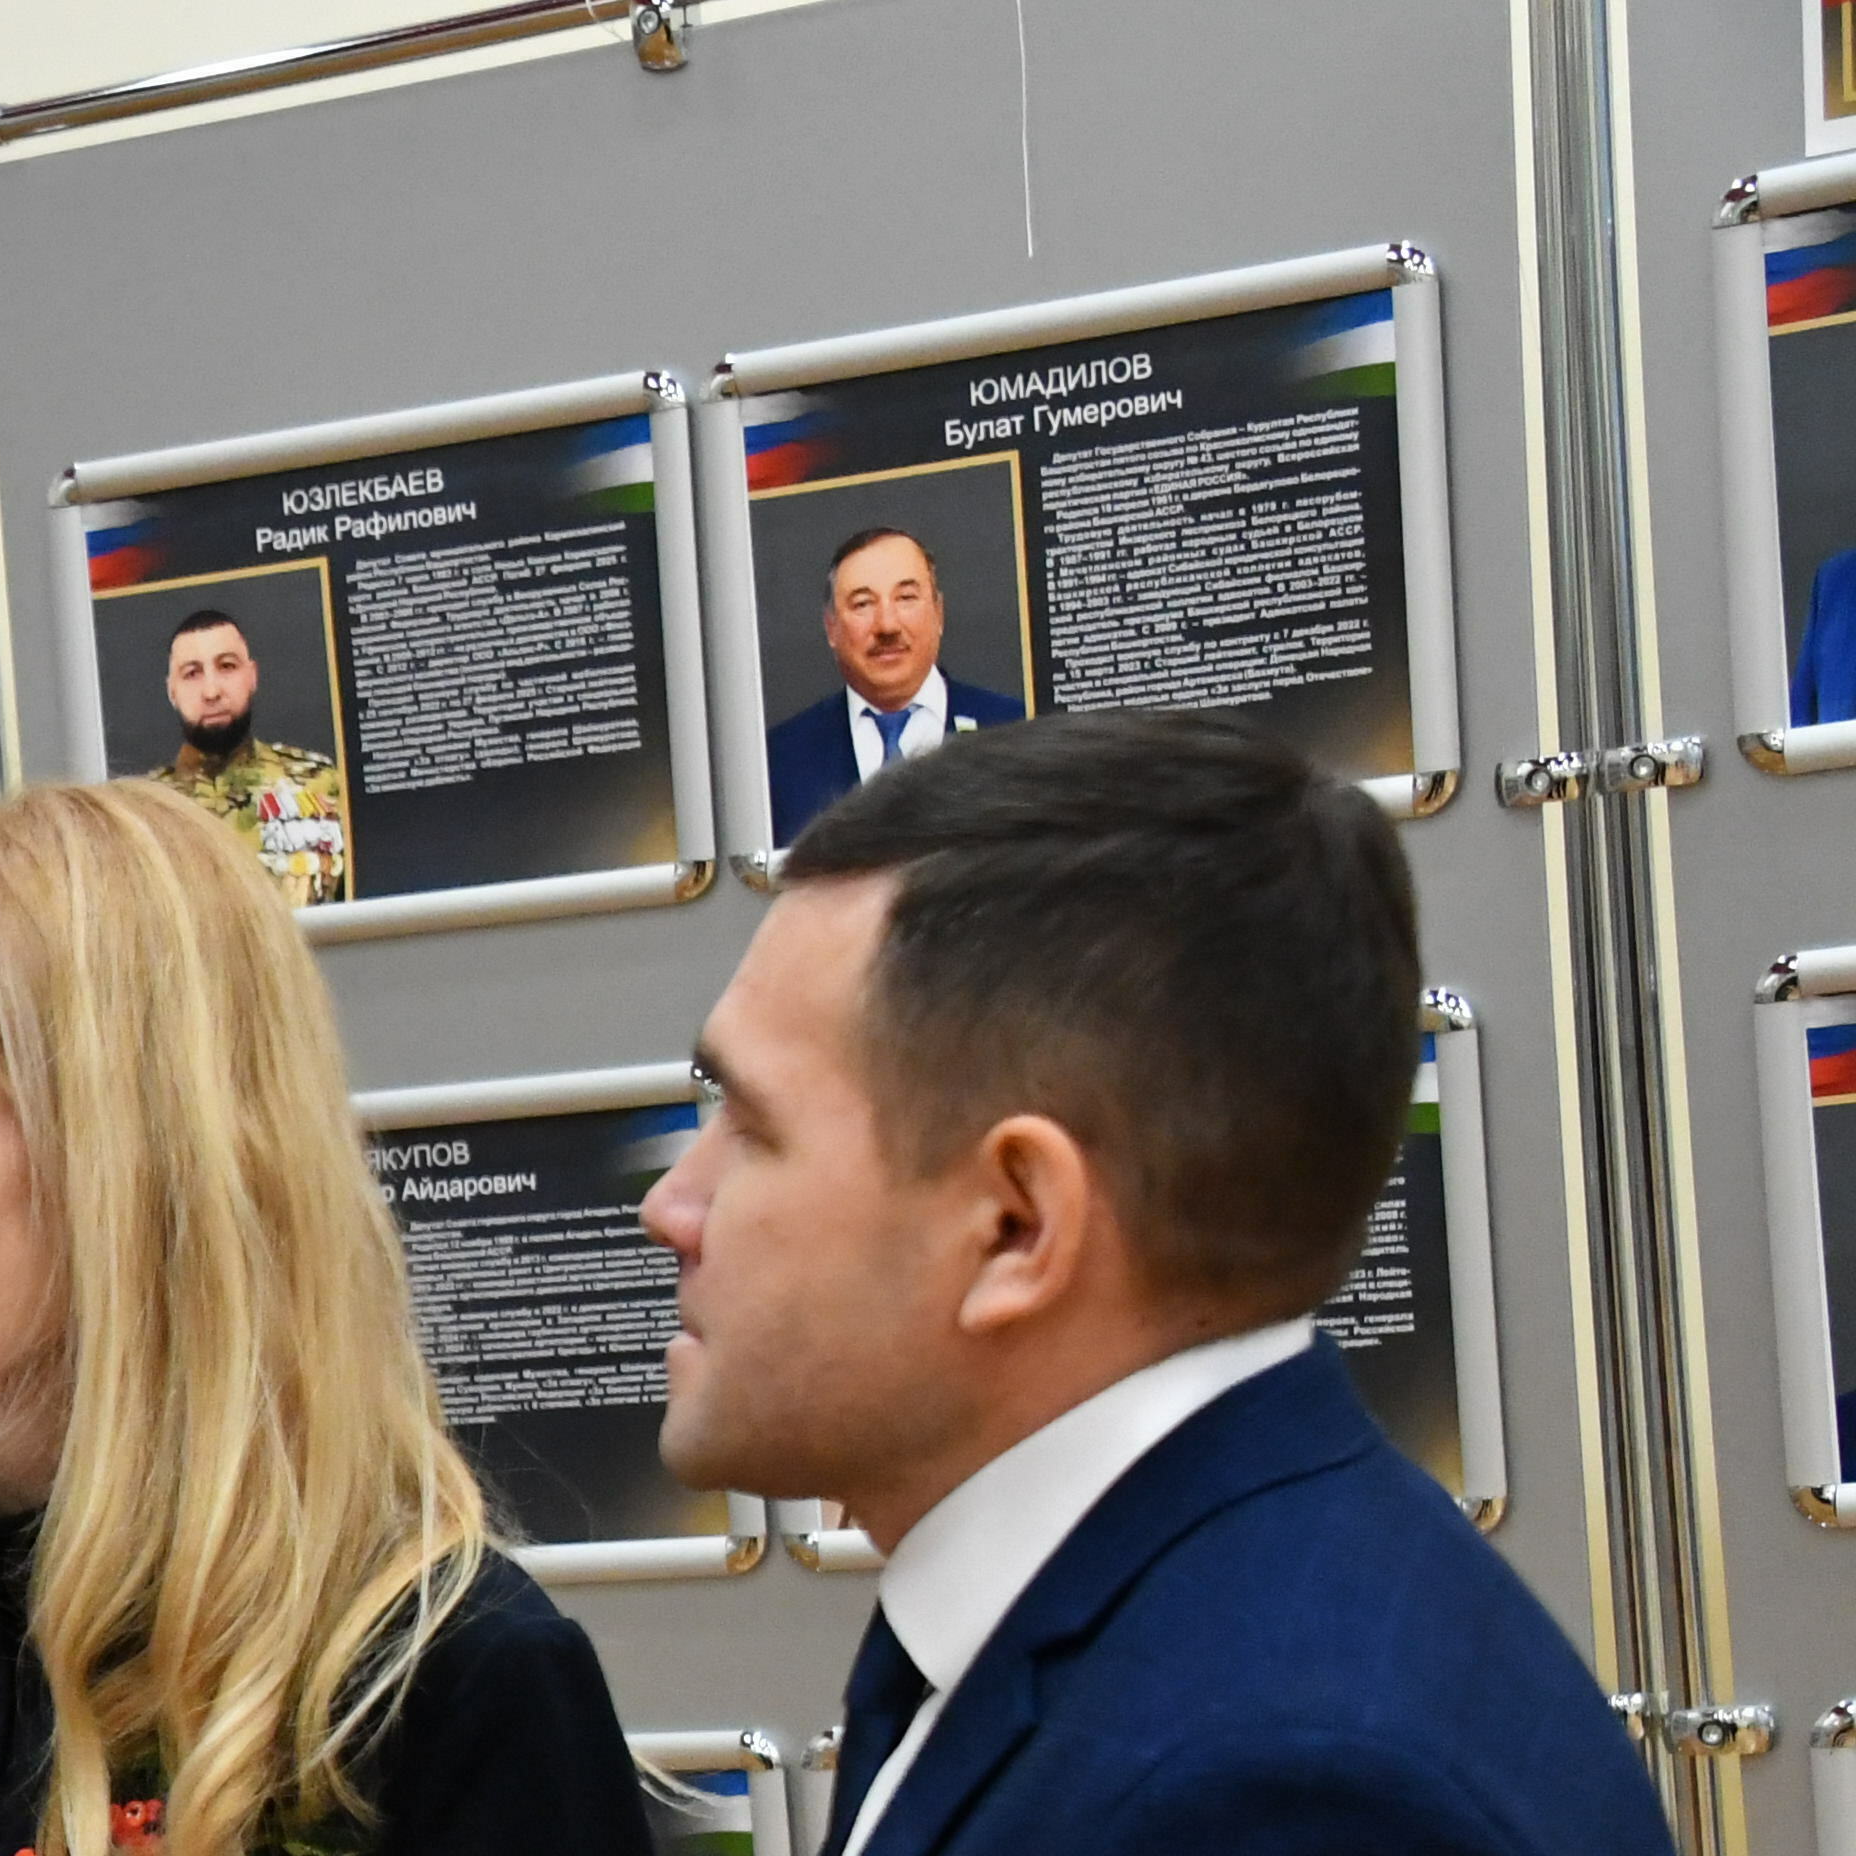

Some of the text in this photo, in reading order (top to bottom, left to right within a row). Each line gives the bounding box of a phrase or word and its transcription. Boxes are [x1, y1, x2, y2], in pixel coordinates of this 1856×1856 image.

[969, 353, 1152, 407] ЮМАДИЛОВ
[945, 389, 1182, 450] Булат Гумерович
[282, 467, 444, 516] ЮЗЛЕКБАЕВ
[255, 501, 477, 553] Радик Рафилович
[401, 1172, 536, 1203] Айдарович
